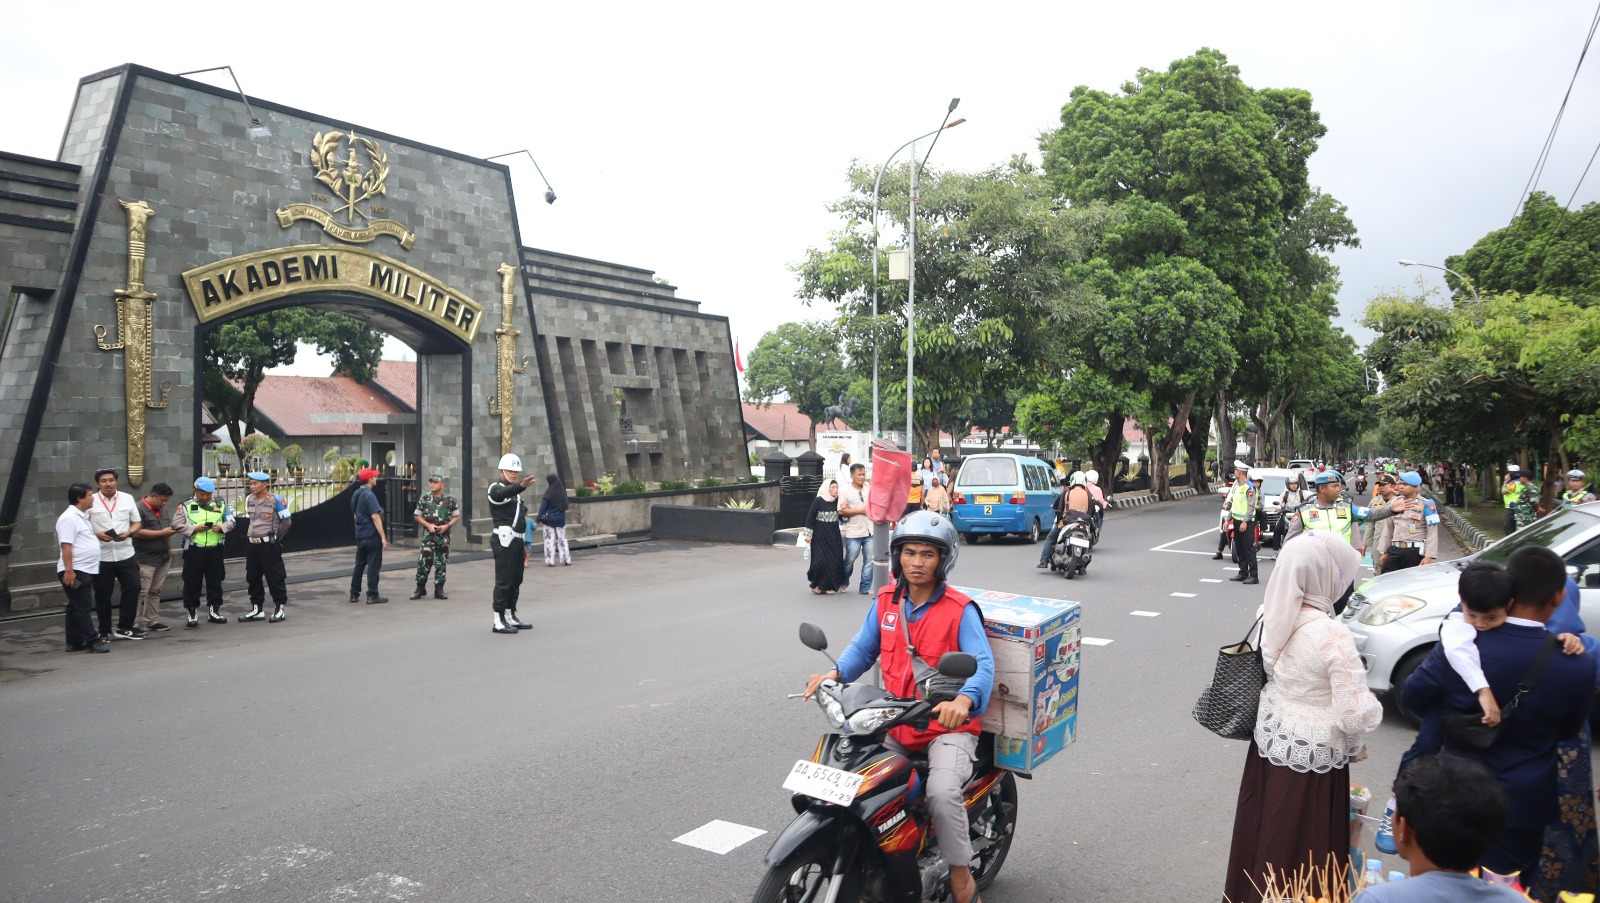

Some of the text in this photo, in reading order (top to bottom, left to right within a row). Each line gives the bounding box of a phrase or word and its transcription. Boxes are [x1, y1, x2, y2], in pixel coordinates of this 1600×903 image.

[200, 254, 475, 331] AKADEMI MILITER
[986, 506, 991, 514] 2
[795, 763, 809, 775] AA
[813, 767, 841, 784] 6549
[877, 809, 906, 834] YAMAHA
